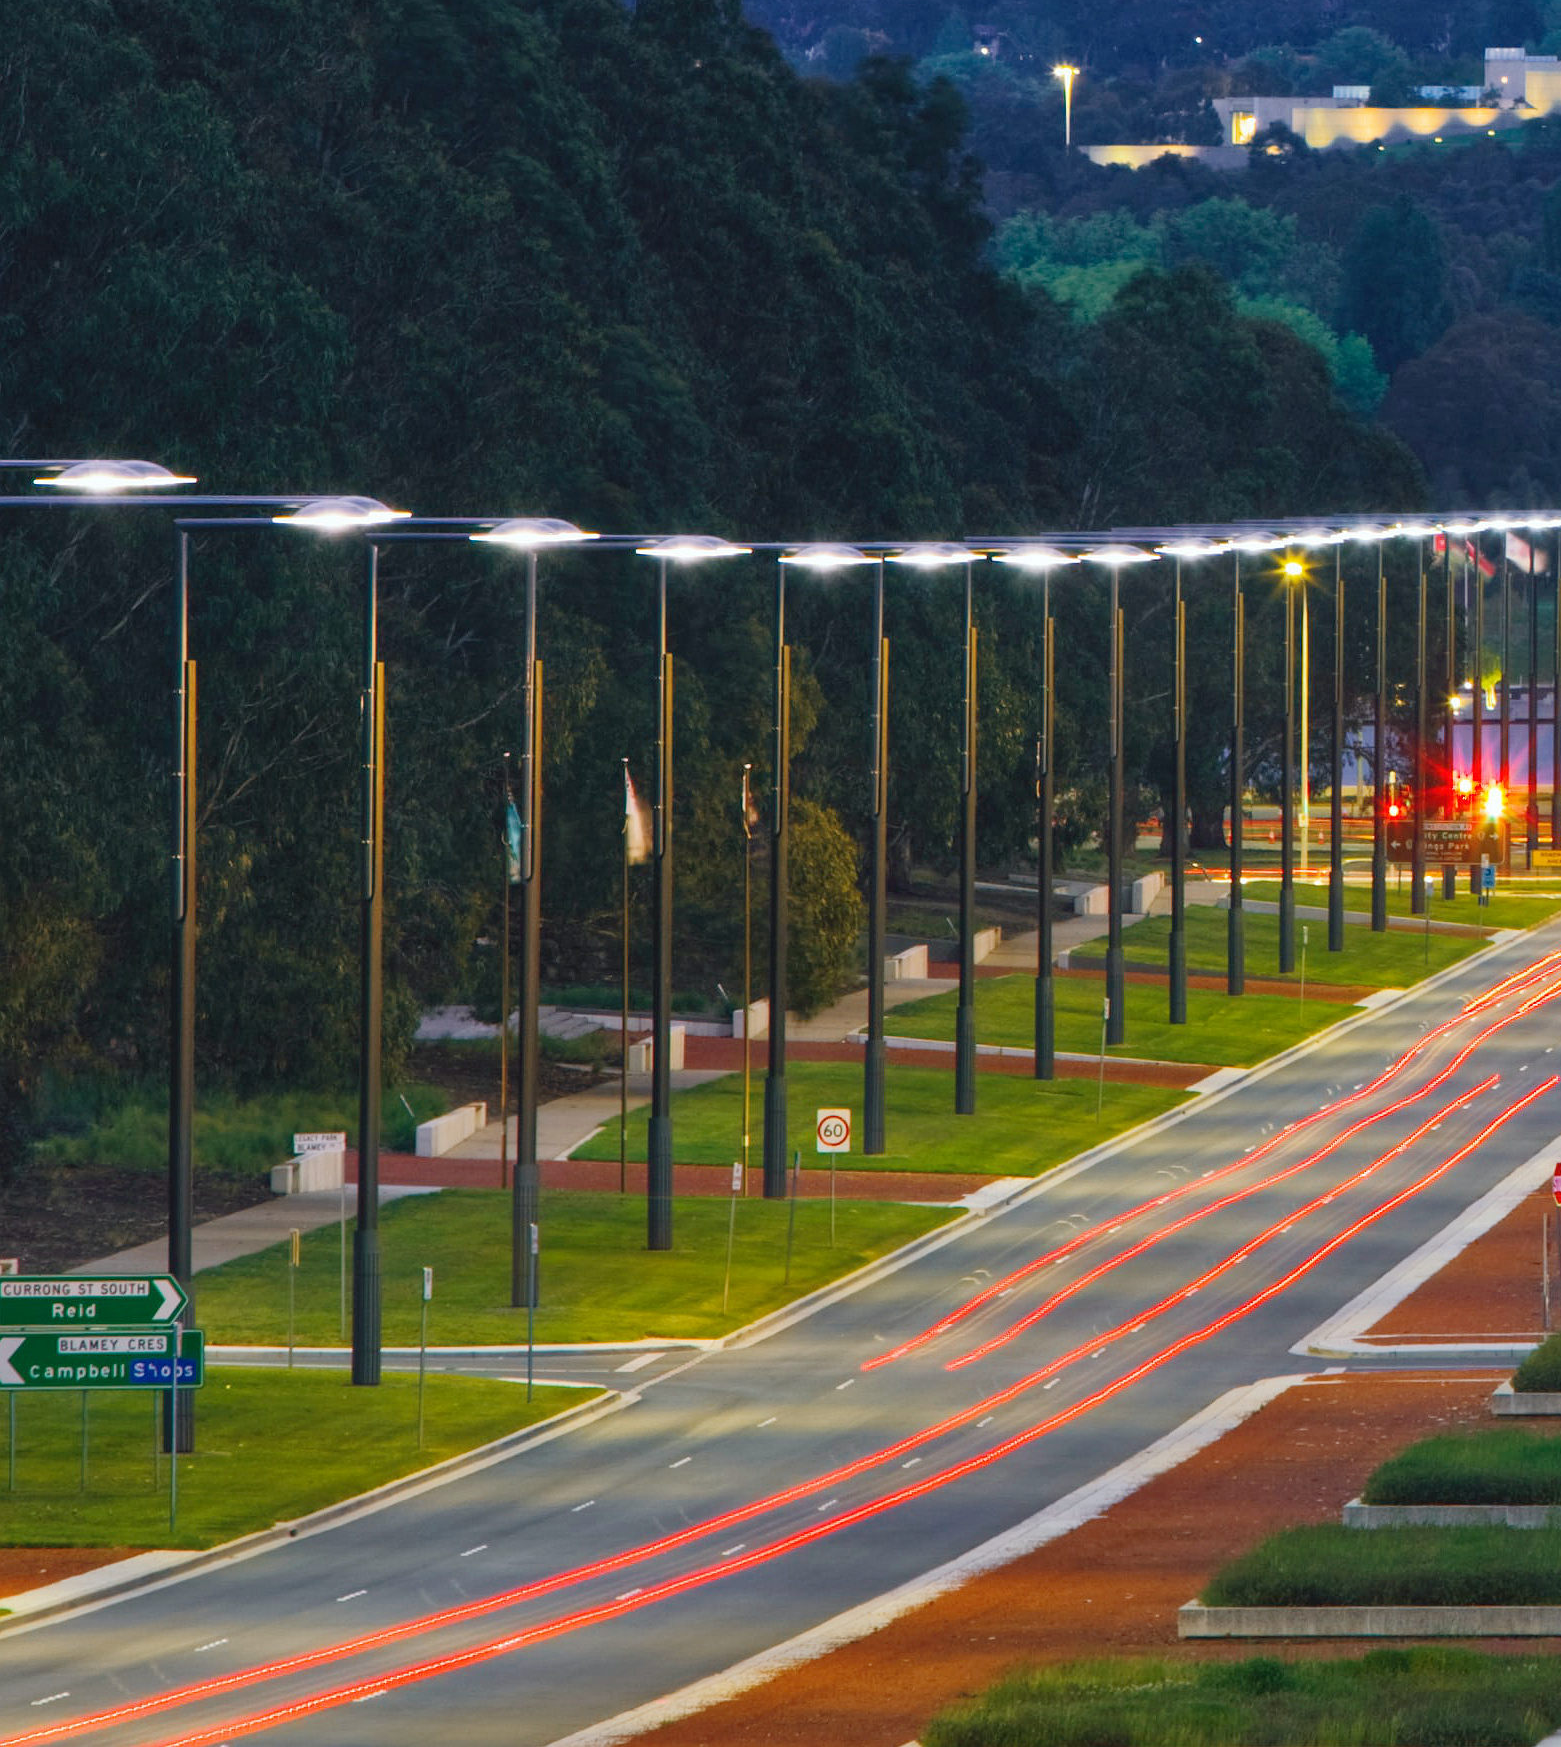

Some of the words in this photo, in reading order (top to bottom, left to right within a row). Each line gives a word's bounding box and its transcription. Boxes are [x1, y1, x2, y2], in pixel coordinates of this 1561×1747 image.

[1442, 832, 1472, 840] Centre
[1424, 842, 1444, 851] ings
[1448, 842, 1469, 850] Park
[823, 1124, 843, 1137] 60
[3, 1283, 71, 1296] CURRONG
[78, 1283, 94, 1295] ST
[101, 1283, 146, 1295] SOUTH
[52, 1303, 96, 1318] Reid
[60, 1339, 119, 1351] BLAMEY
[128, 1338, 165, 1350] CRES
[30, 1363, 125, 1381] Campbell
